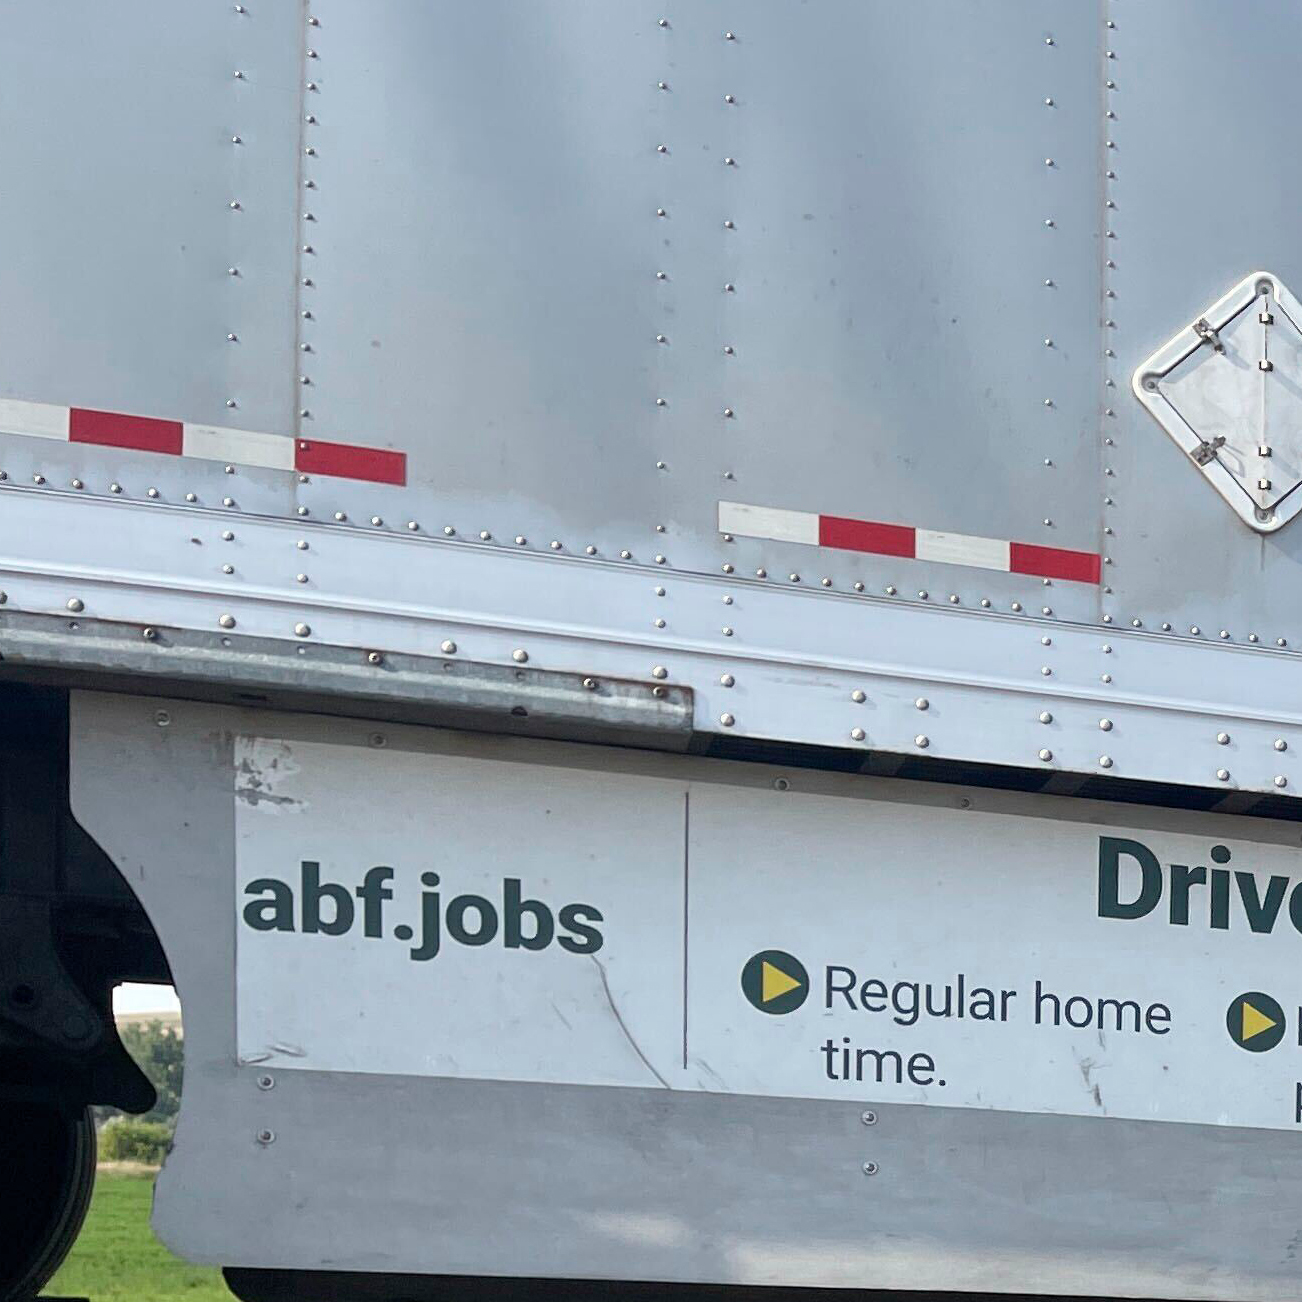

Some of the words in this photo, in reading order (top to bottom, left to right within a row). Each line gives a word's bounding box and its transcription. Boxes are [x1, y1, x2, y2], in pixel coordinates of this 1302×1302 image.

[243, 861, 604, 961] abf.jobs
[826, 965, 1017, 1026] Regular
[1035, 980, 1172, 1035] home
[820, 1037, 946, 1087] time.
